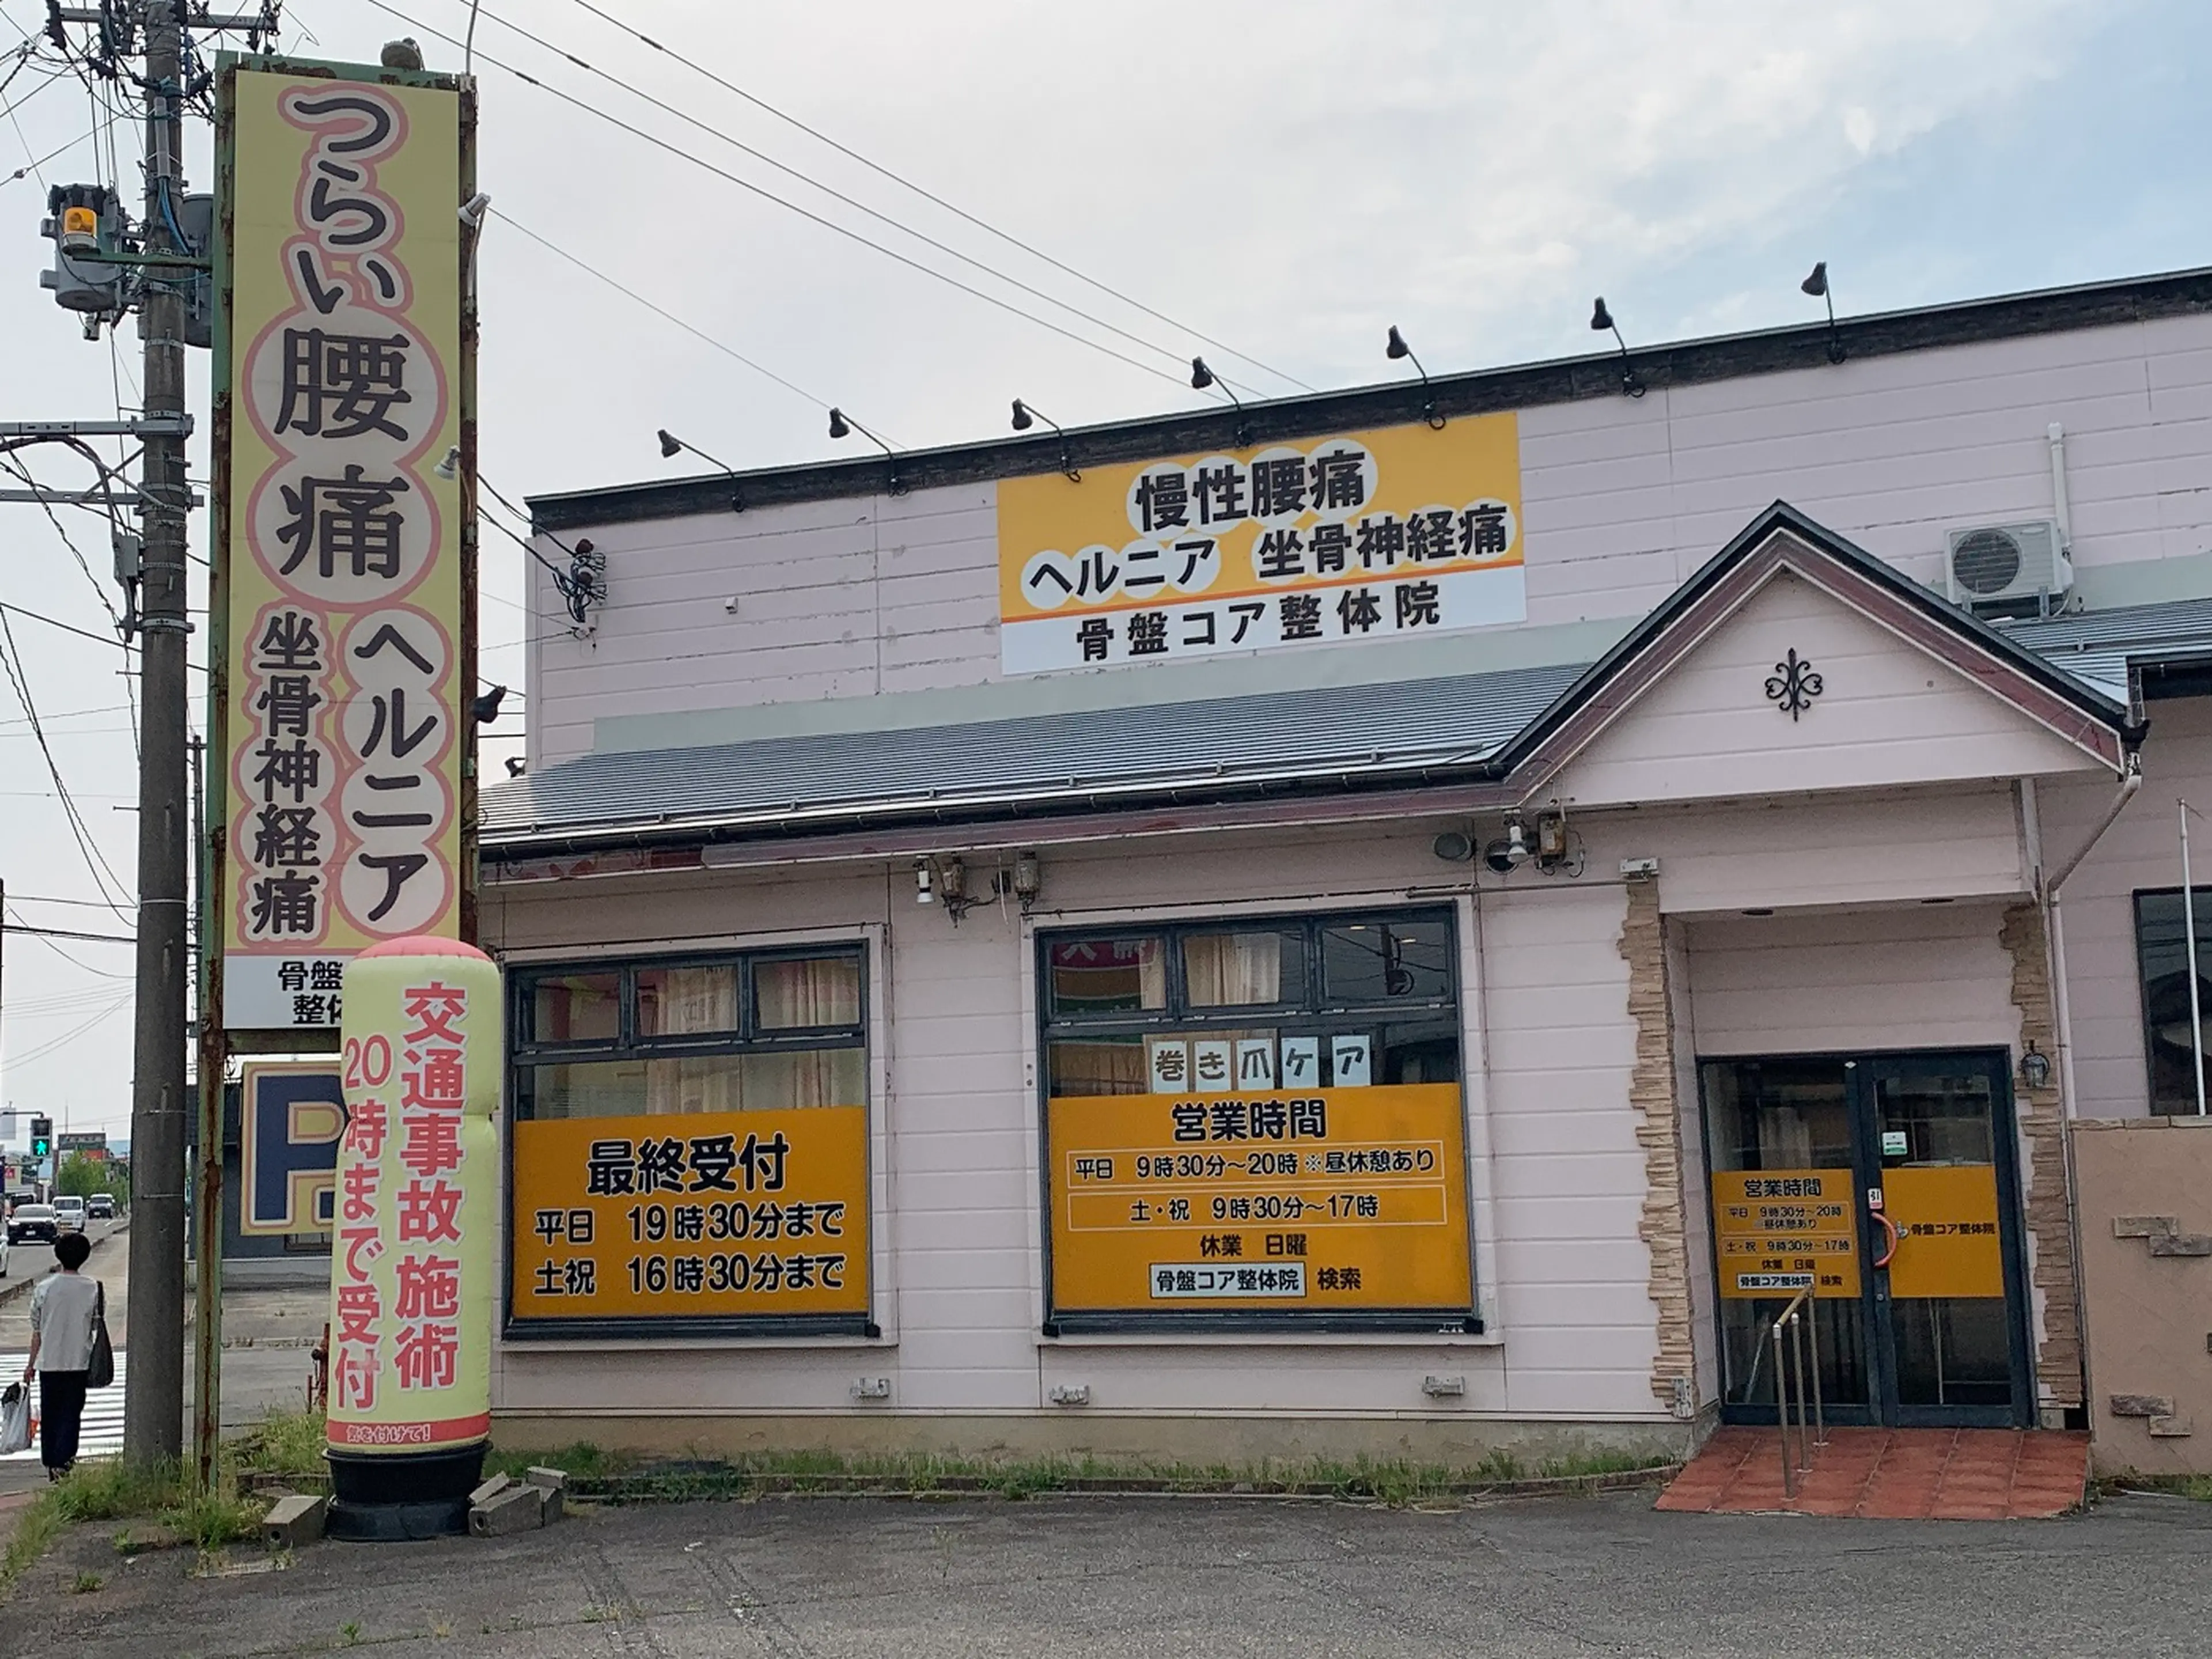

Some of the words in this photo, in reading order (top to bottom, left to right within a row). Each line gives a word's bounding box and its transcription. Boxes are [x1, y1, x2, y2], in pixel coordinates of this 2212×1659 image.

[274, 97, 411, 578] つらい腰痛
[1134, 449, 1366, 532] 慢性腰痛
[1029, 539, 1215, 598] ヘルニア
[1257, 505, 1508, 579] 坐骨神経痛
[1077, 579, 1440, 662] 骨盤コア整体院
[253, 612, 322, 934] 坐骨神経痛
[353, 624, 437, 921] ヘルニア
[1155, 1046, 1365, 1081] 巻き爪ケア
[1172, 1099, 1326, 1142] 営業時間
[394, 981, 466, 1389] 交通事故施術
[586, 1131, 790, 1195] 最終受付
[1075, 1158, 1113, 1179] 平日
[1744, 1178, 1822, 1198] 営業時間
[334, 1035, 391, 1410] 20時まで受付
[535, 1210, 594, 1244] 平日
[628, 1202, 845, 1241] 19時30分まで
[1200, 1234, 1242, 1256] 休業
[1266, 1234, 1307, 1256] 日曜
[533, 1259, 596, 1295] 土祝
[627, 1253, 846, 1294] 16時30分まで
[1156, 1268, 1300, 1292] 骨盤コア整体院
[1317, 1268, 1362, 1290] 検索
